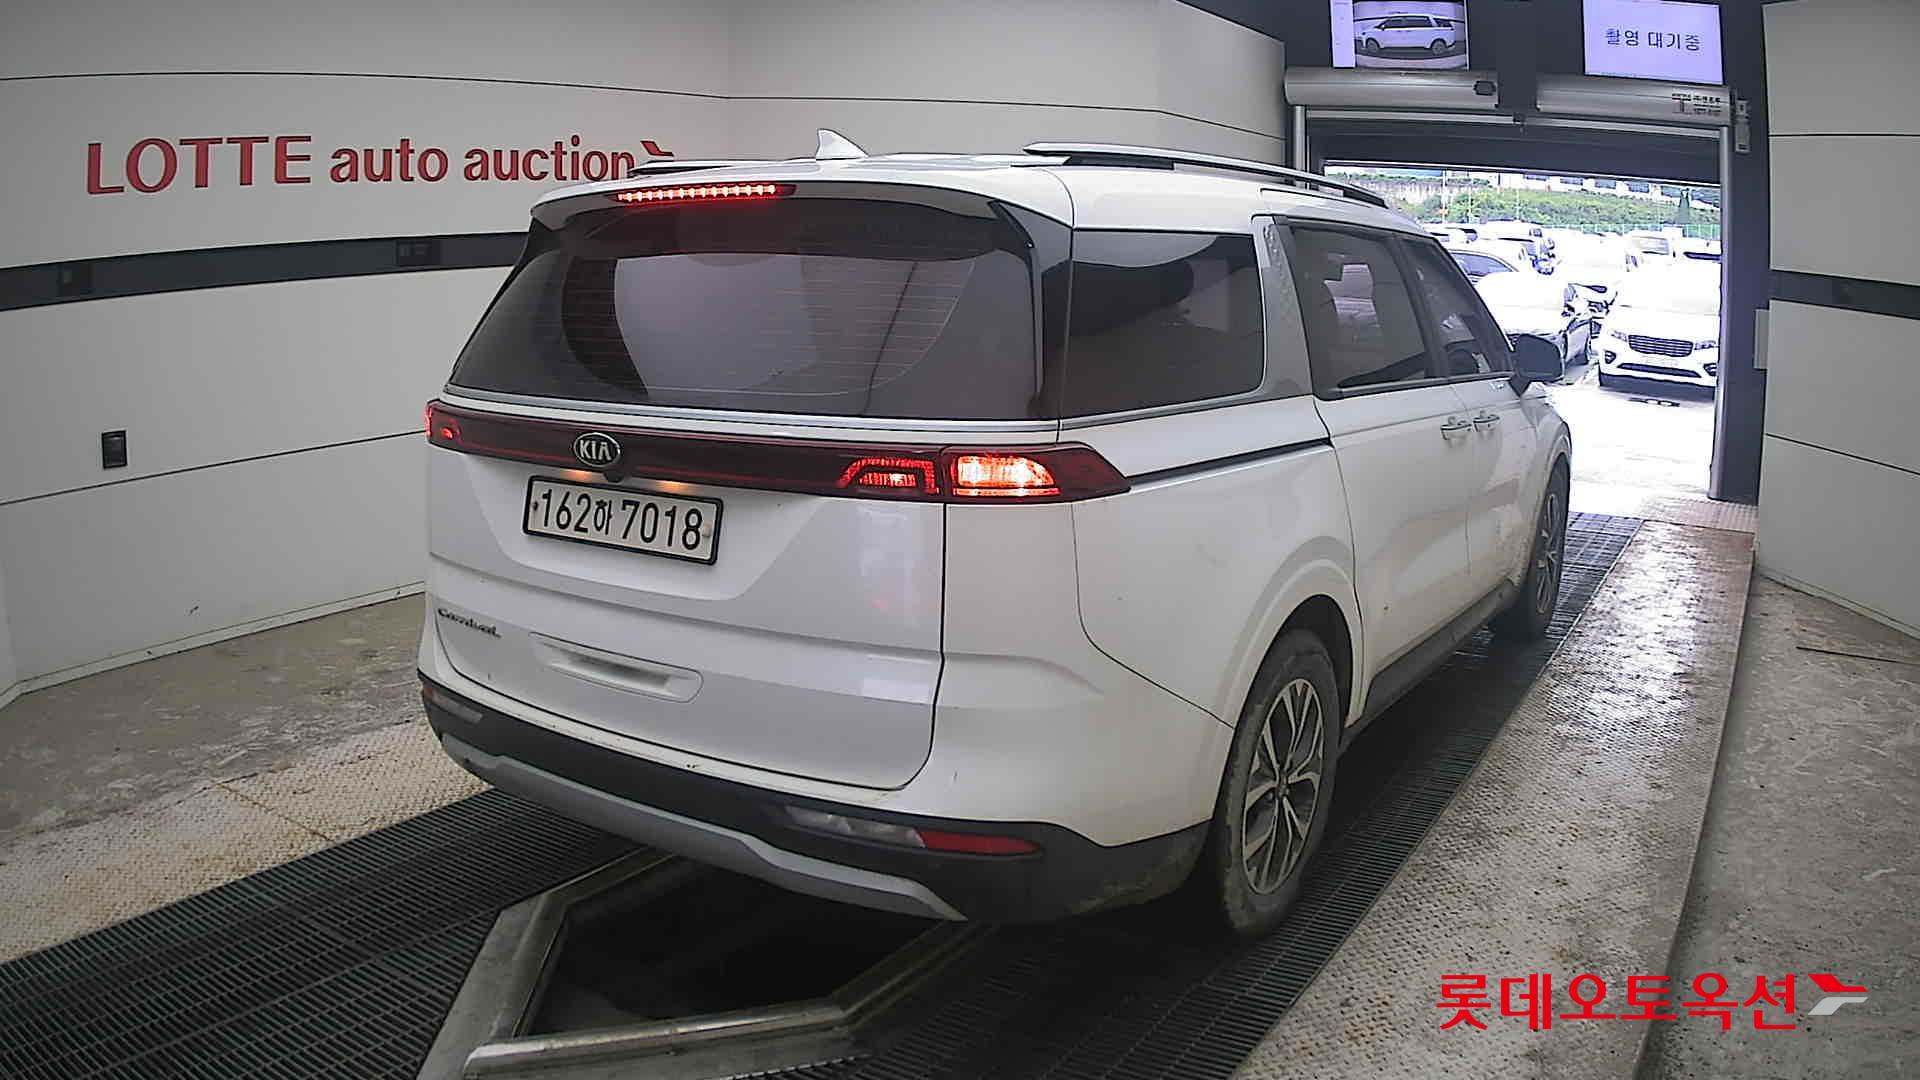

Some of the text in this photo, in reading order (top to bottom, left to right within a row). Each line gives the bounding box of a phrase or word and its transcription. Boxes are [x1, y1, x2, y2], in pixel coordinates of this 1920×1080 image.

[1647, 31, 1700, 51] 대기중
[86, 135, 635, 195] LOTTE auto auction
[579, 439, 612, 462] KIA
